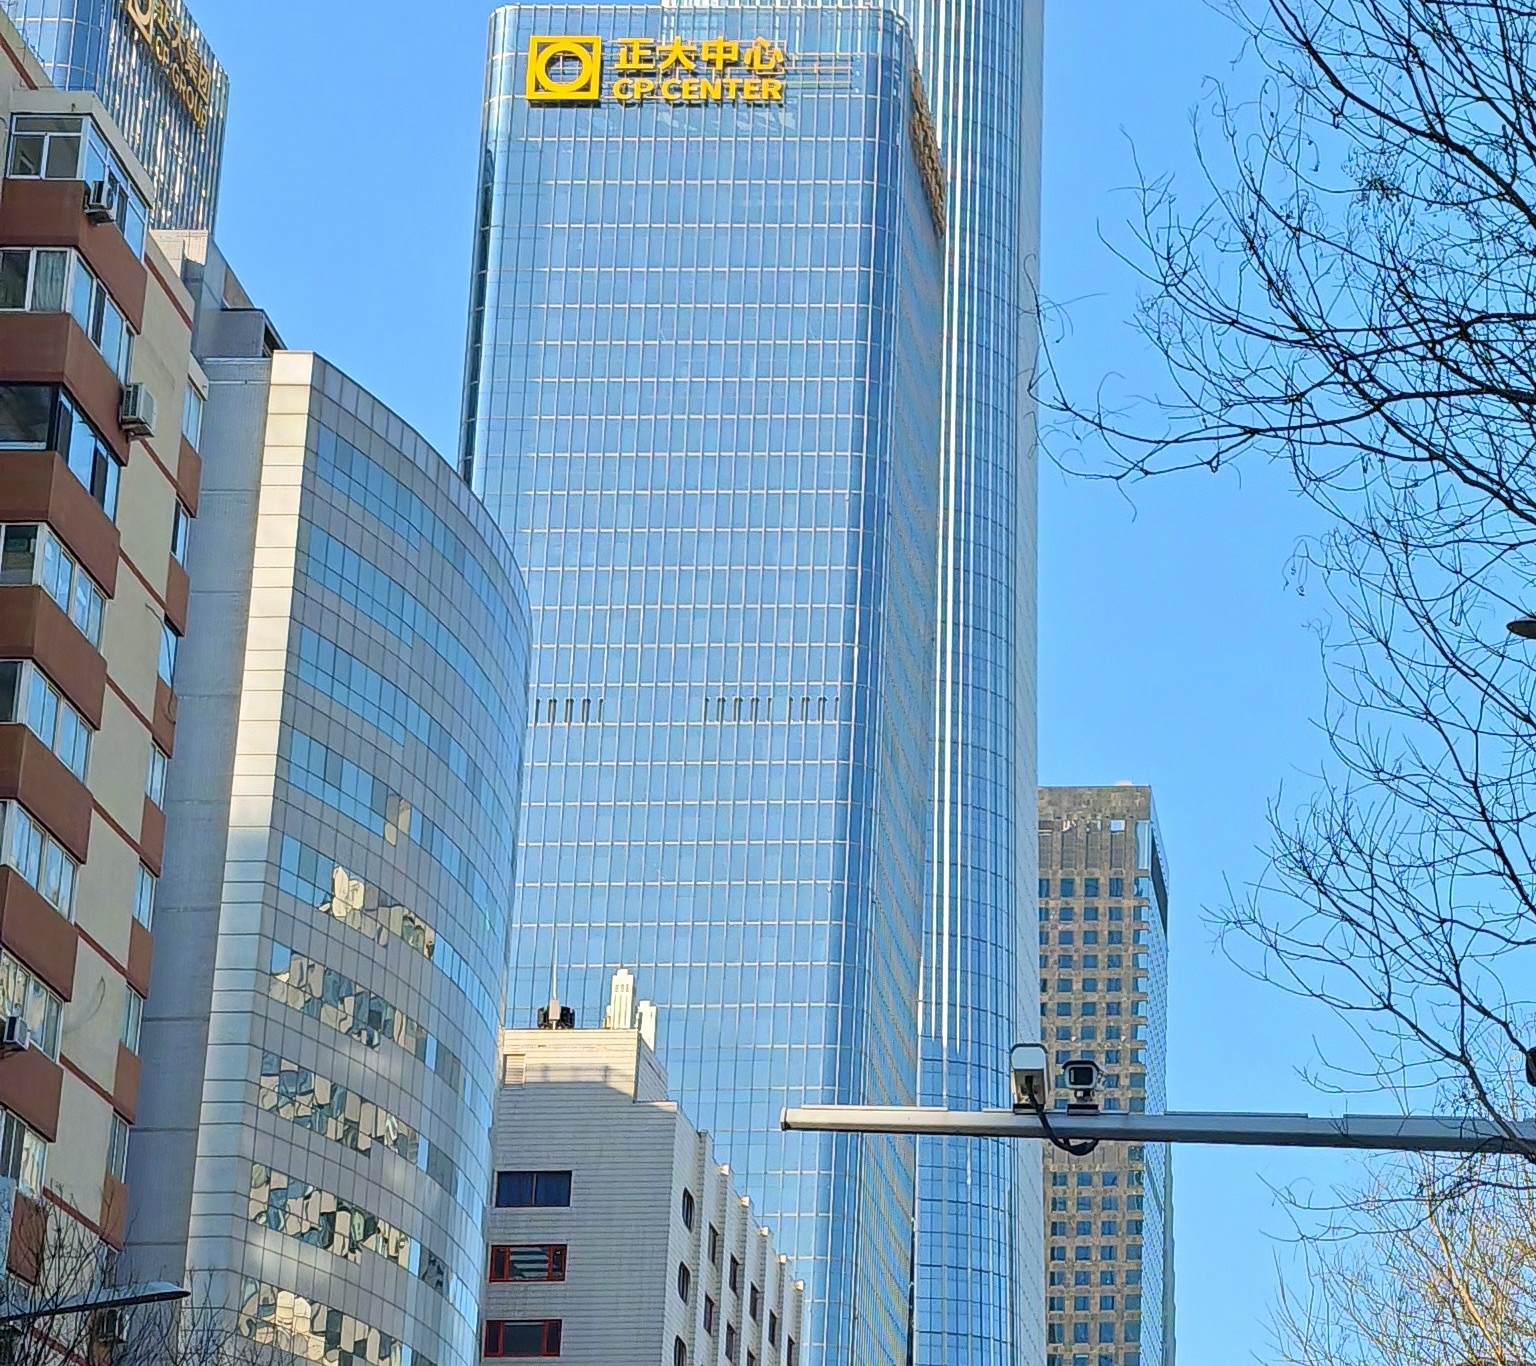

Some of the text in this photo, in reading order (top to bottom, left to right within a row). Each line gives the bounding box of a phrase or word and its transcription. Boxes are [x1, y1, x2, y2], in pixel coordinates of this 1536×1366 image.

[614, 36, 784, 71] 正大中心
[155, 35, 209, 129] CP GROUP
[612, 77, 783, 101] CP CENTER
